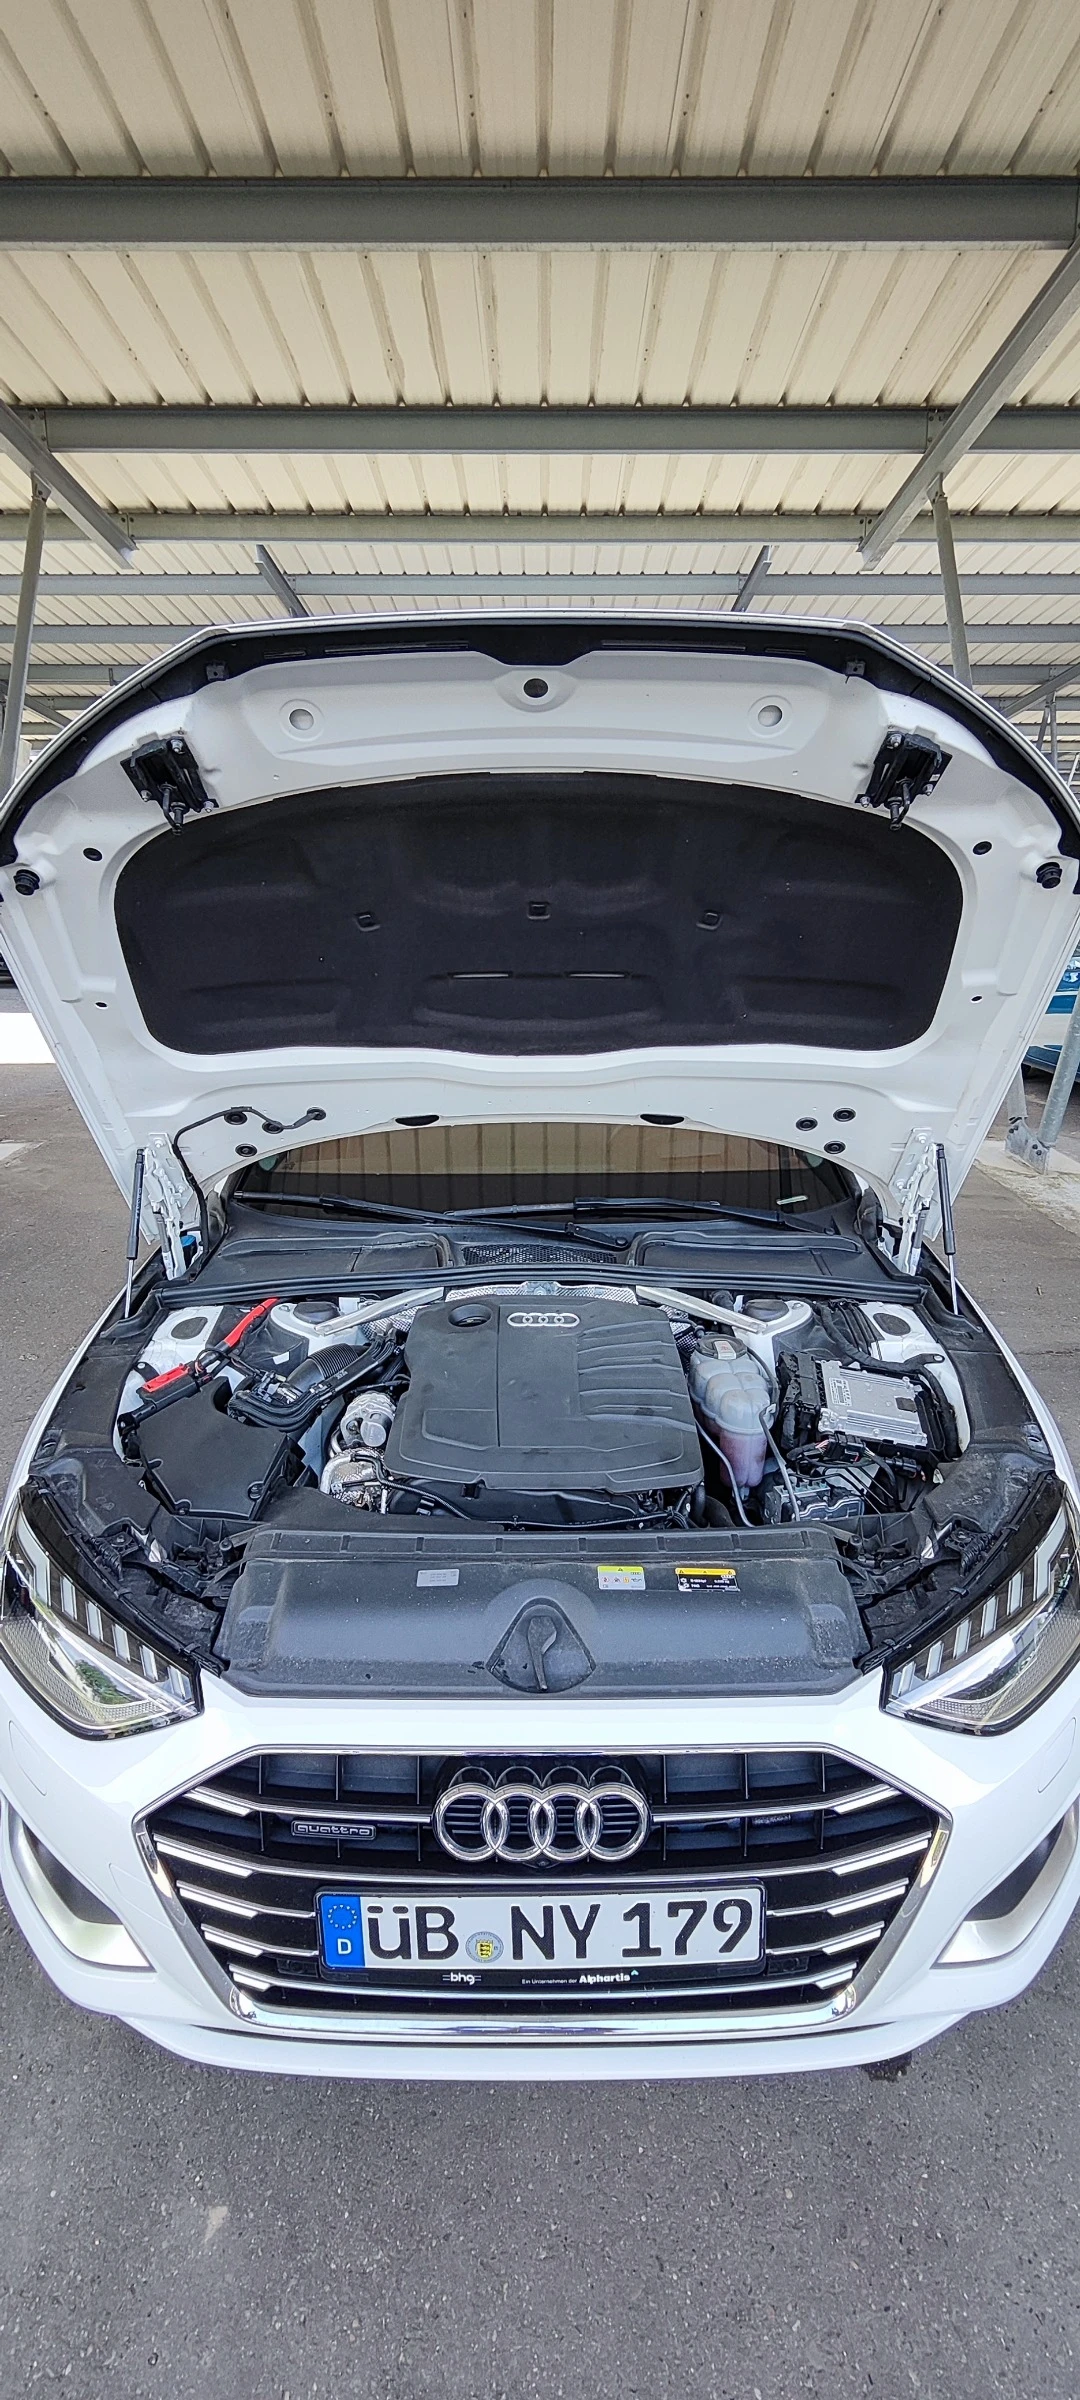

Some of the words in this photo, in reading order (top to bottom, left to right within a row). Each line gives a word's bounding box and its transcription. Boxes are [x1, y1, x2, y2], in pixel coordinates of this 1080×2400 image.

[297, 1825, 370, 1835] quattro
[511, 1904, 600, 1960] NY
[622, 1899, 753, 1957] 179
[337, 1938, 352, 1955] D
[450, 1972, 475, 1985] bhg
[579, 1972, 631, 1985] Alphartis
